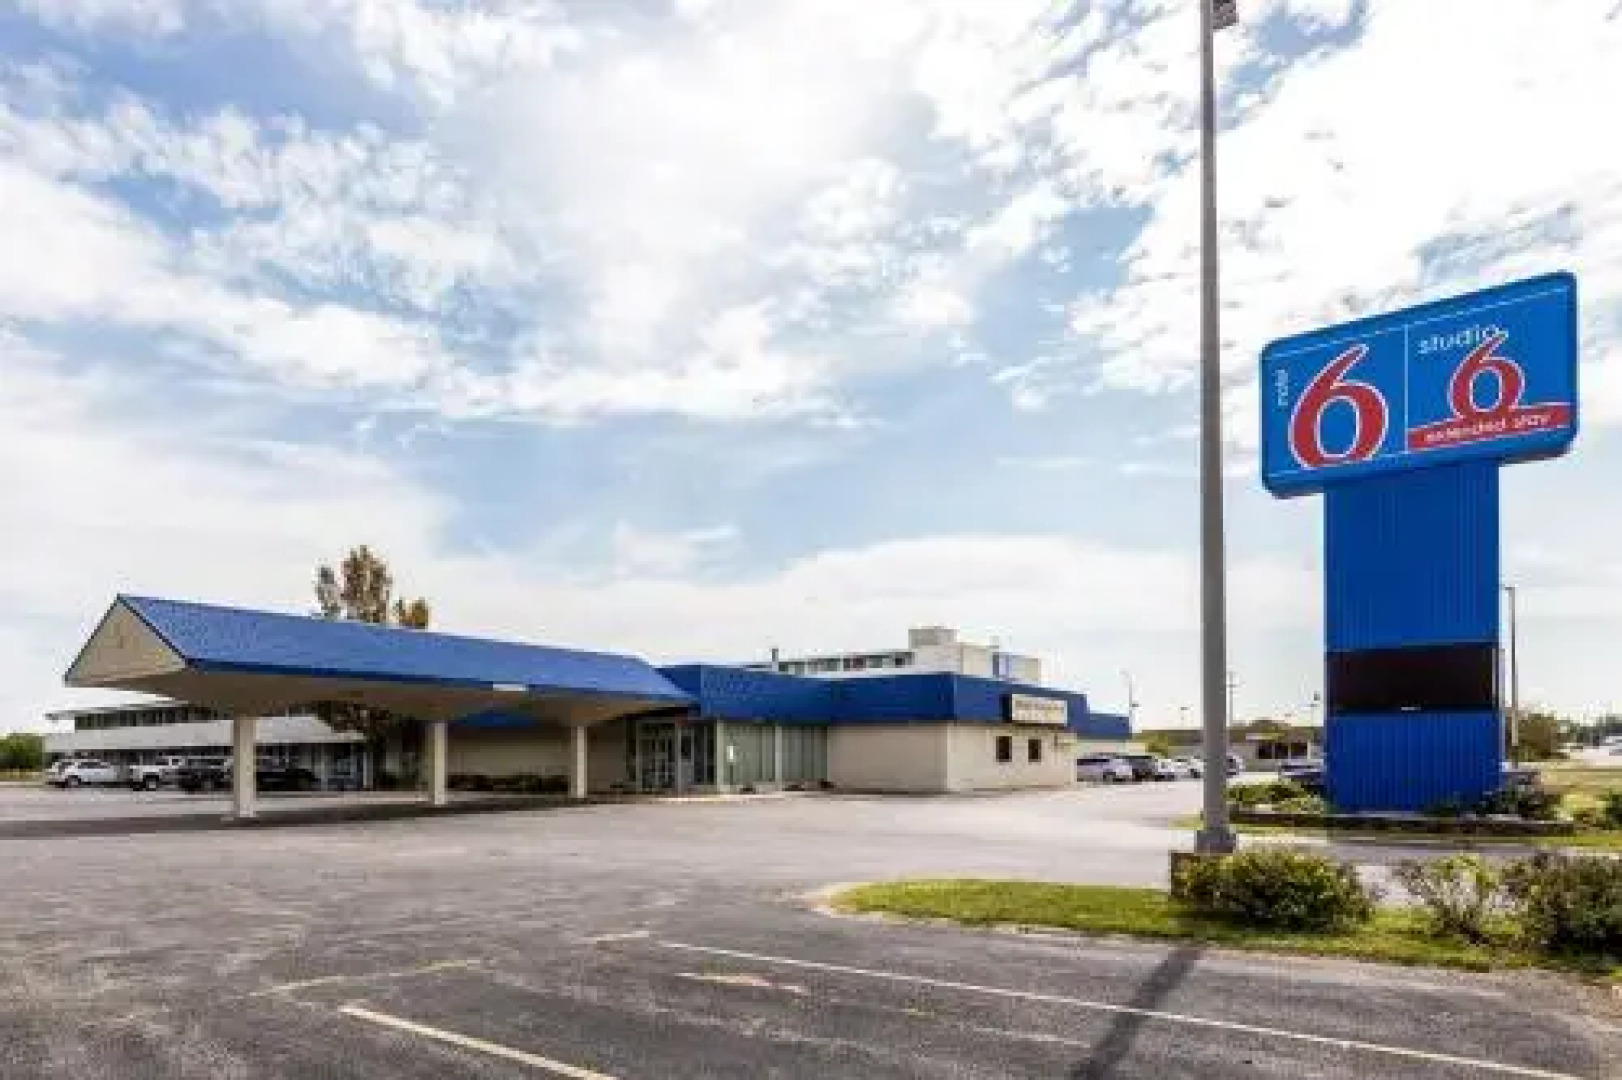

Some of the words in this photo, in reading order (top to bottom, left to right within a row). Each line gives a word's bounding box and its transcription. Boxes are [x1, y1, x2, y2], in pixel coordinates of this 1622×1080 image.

[1417, 324, 1508, 354] studio
[1449, 331, 1526, 421] 6
[1289, 343, 1388, 470] 6
